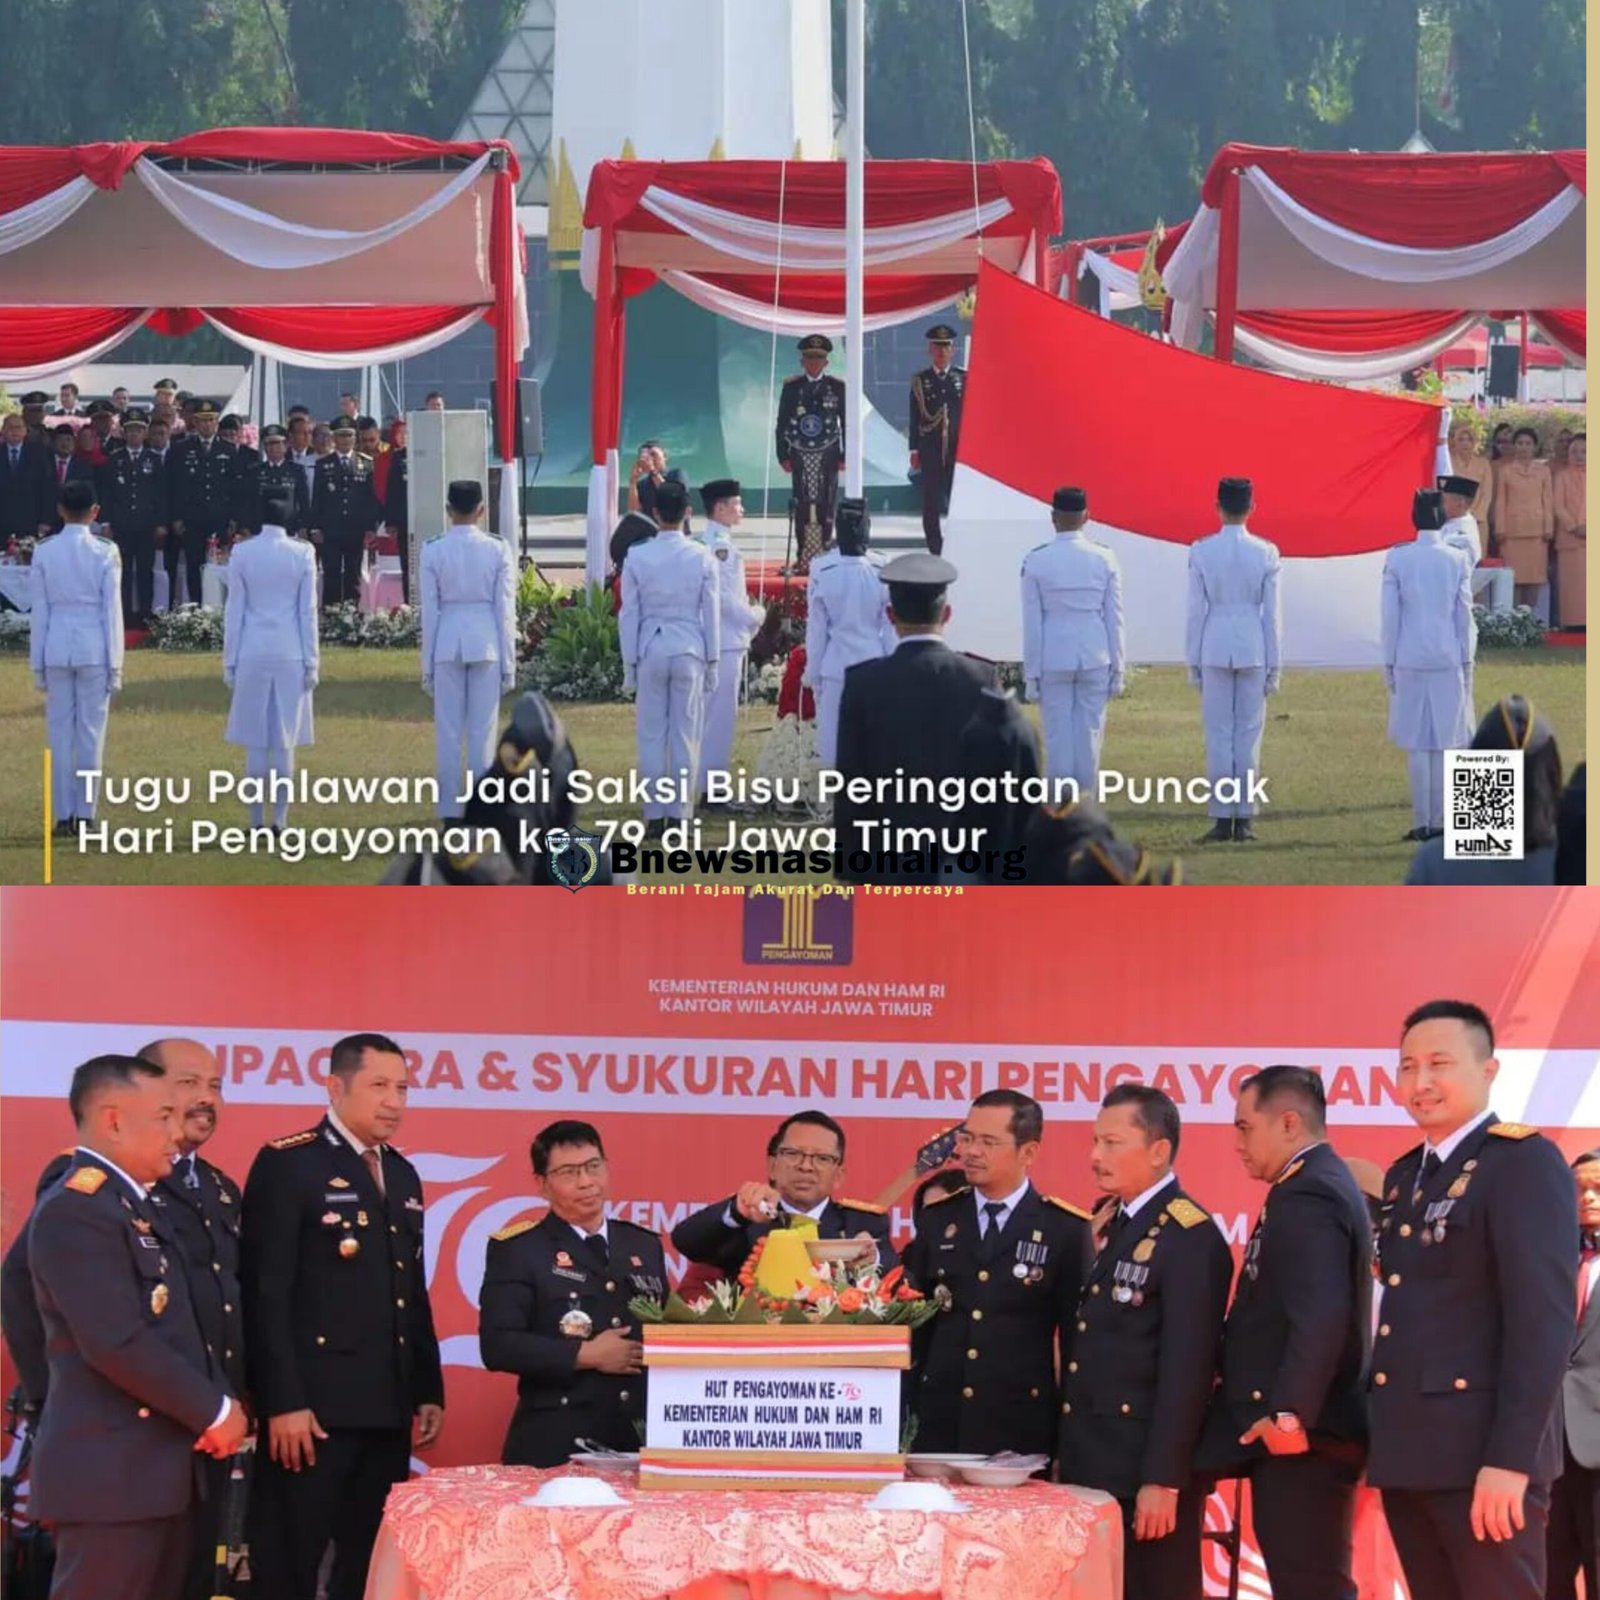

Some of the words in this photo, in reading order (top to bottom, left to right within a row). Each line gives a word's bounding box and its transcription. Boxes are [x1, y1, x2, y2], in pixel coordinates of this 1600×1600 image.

[761, 950, 833, 961] PENGAYOMAN
[648, 979, 769, 996] KEMENTERIAN
[773, 981, 838, 997] HUKUM
[842, 982, 880, 997] DAN
[884, 983, 926, 998] HAM
[929, 984, 946, 998] RI
[659, 998, 732, 1014] KANTOR
[736, 999, 816, 1015] WILAYAH
[820, 1001, 874, 1016] JAWA
[879, 1002, 934, 1017] TIMUR
[477, 1051, 517, 1092] &
[532, 1052, 837, 1098] SYUKURAN
[852, 1059, 982, 1100] HARI
[704, 1380, 728, 1398] HUT
[733, 1381, 816, 1400] PENGAYOMAN
[664, 1405, 749, 1423] KEMENTERIAN
[754, 1406, 799, 1424] HUKUM
[804, 1406, 829, 1425] DAN
[836, 1407, 864, 1425] HAM
[869, 1407, 882, 1425] RI
[682, 1429, 731, 1447] KANTOR
[734, 1430, 787, 1449] WILAYAH
[789, 1431, 822, 1449] JAWA
[825, 1431, 863, 1450] TIMUR
